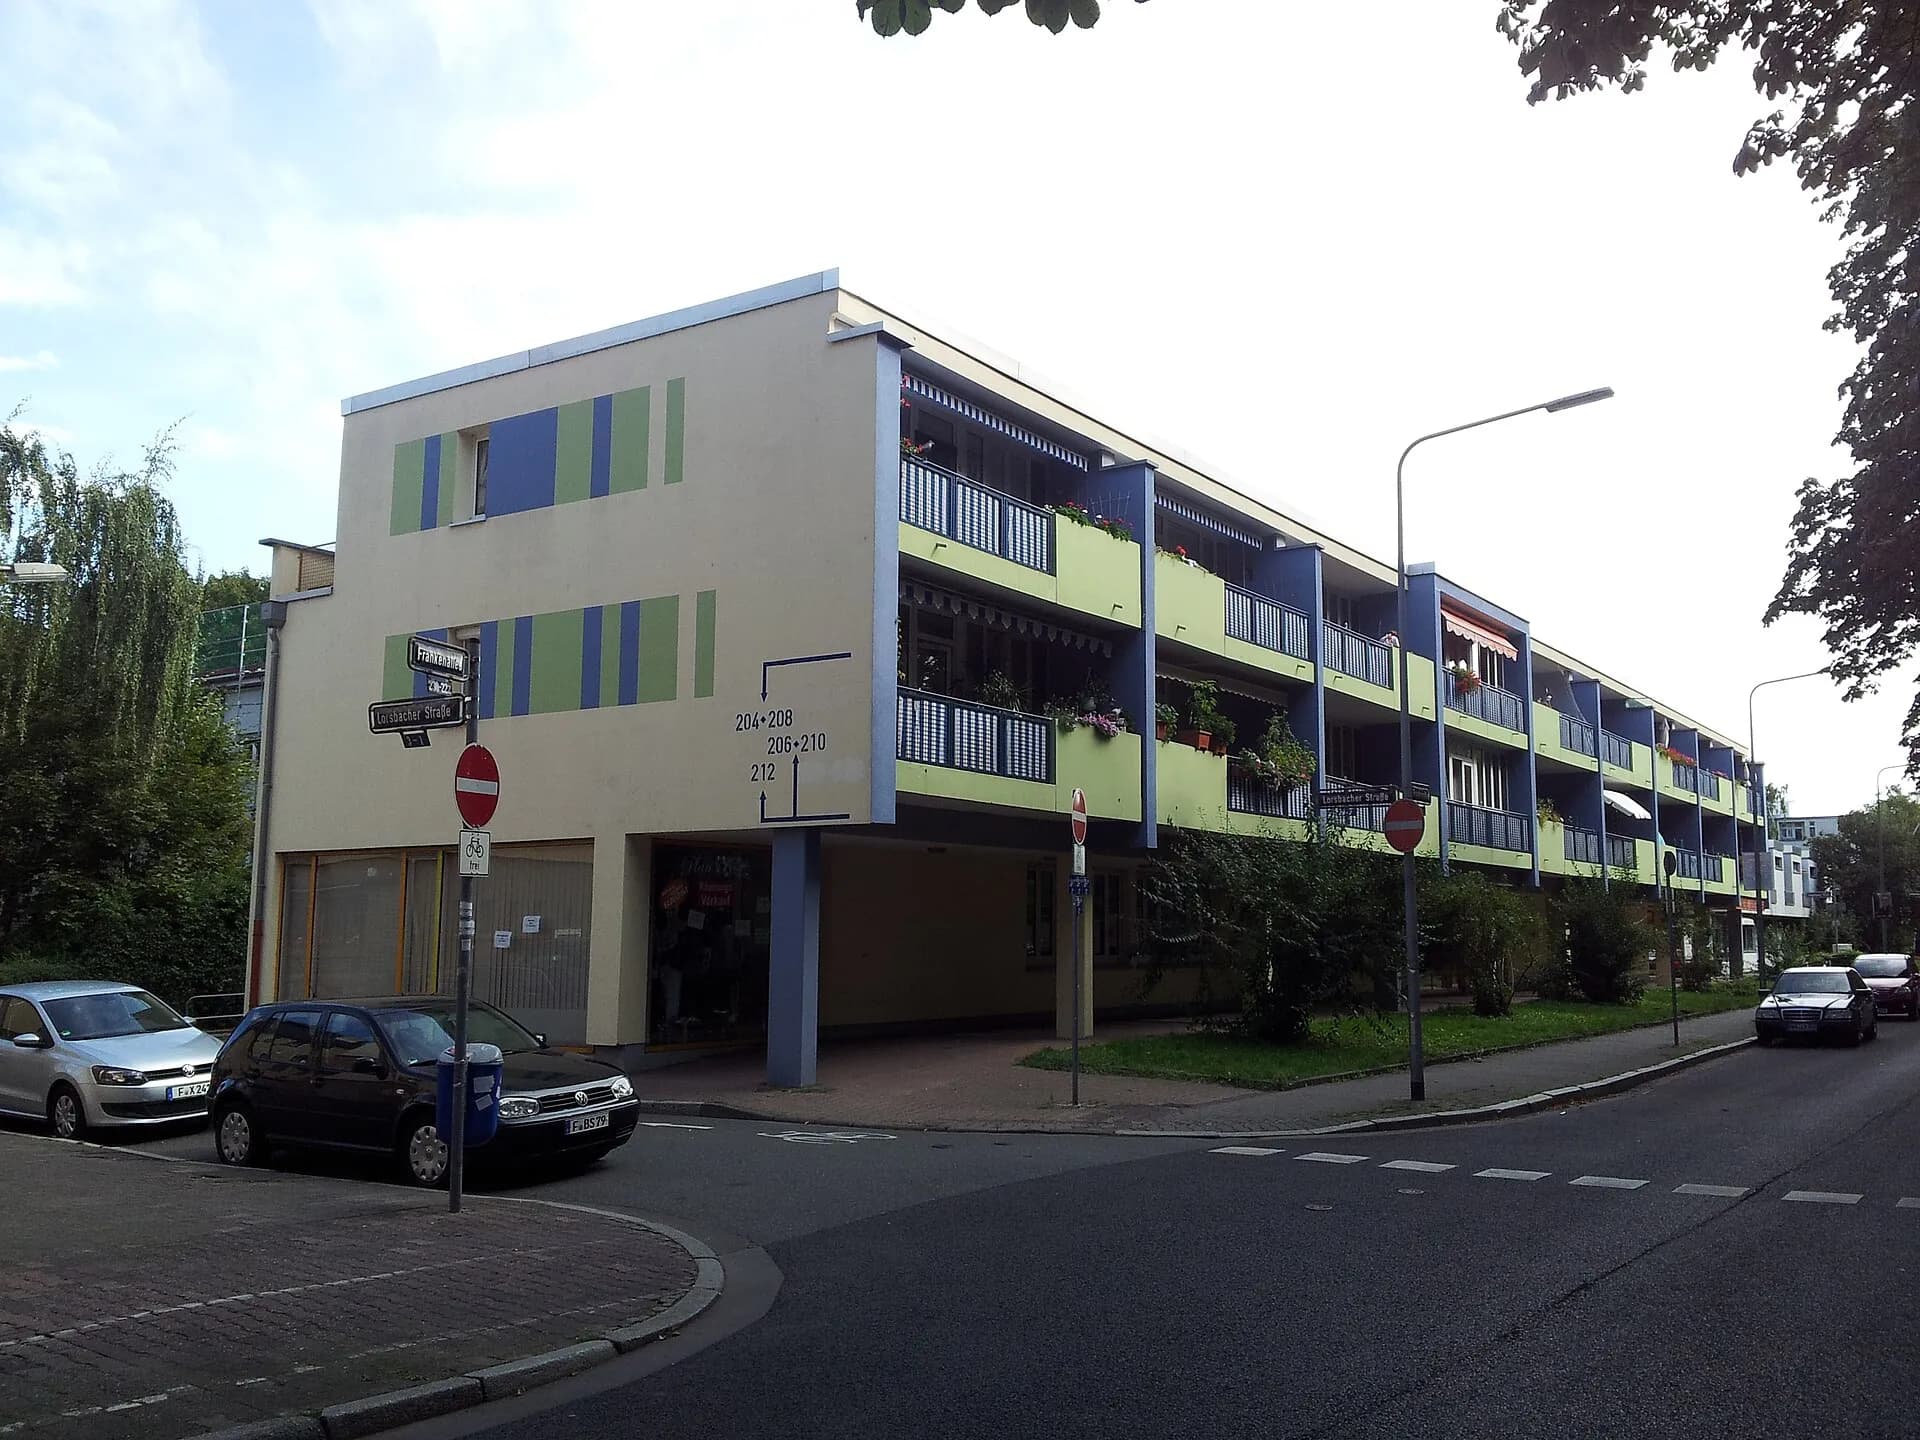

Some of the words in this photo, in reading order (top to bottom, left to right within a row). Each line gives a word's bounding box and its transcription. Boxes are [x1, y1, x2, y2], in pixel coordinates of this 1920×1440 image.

[376, 710, 421, 725] Lorsbacher
[424, 704, 451, 720] Straße
[751, 763, 776, 782] 212
[1322, 794, 1363, 804] Lorsbacher
[1365, 792, 1389, 803] Straße
[469, 860, 480, 871] frei
